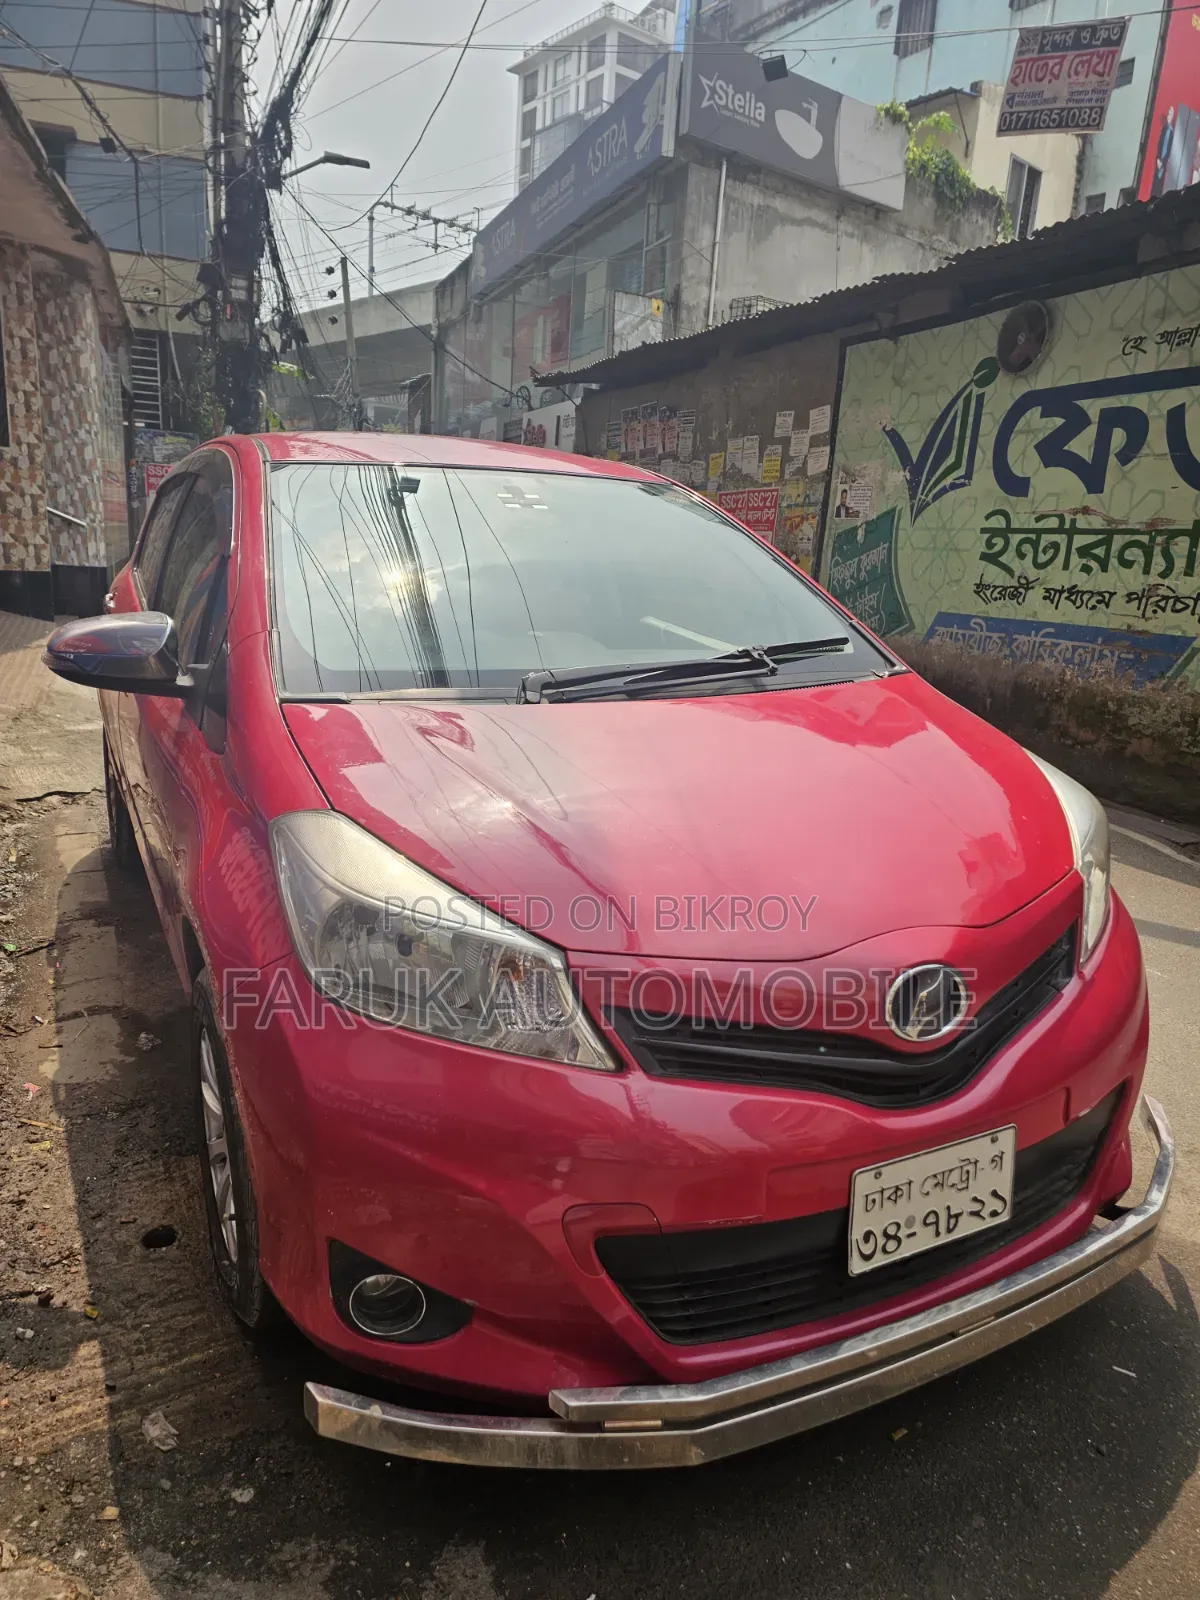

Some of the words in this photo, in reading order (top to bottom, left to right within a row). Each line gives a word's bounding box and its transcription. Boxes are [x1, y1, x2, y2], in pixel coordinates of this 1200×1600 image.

[1041, 28, 1077, 52] সুন্দর
[1080, 27, 1092, 44] ও
[1092, 22, 1125, 46] দ্রুত
[1010, 54, 1068, 88] হাতের
[1067, 48, 1119, 79] লেখা
[714, 79, 766, 123] Stella
[1000, 107, 1101, 131] 01711651088
[587, 116, 628, 177] ASTRA
[1155, 322, 1200, 353] আল্লা
[721, 493, 746, 509] SSC'27
[748, 491, 778, 507] SSC'27
[1042, 584, 1117, 611] মাধ্যমে
[1126, 582, 1200, 622] পরিচা
[864, 1179, 914, 1212] ঢাকা
[856, 1188, 1008, 1262] ৩৪-৭৮২১
